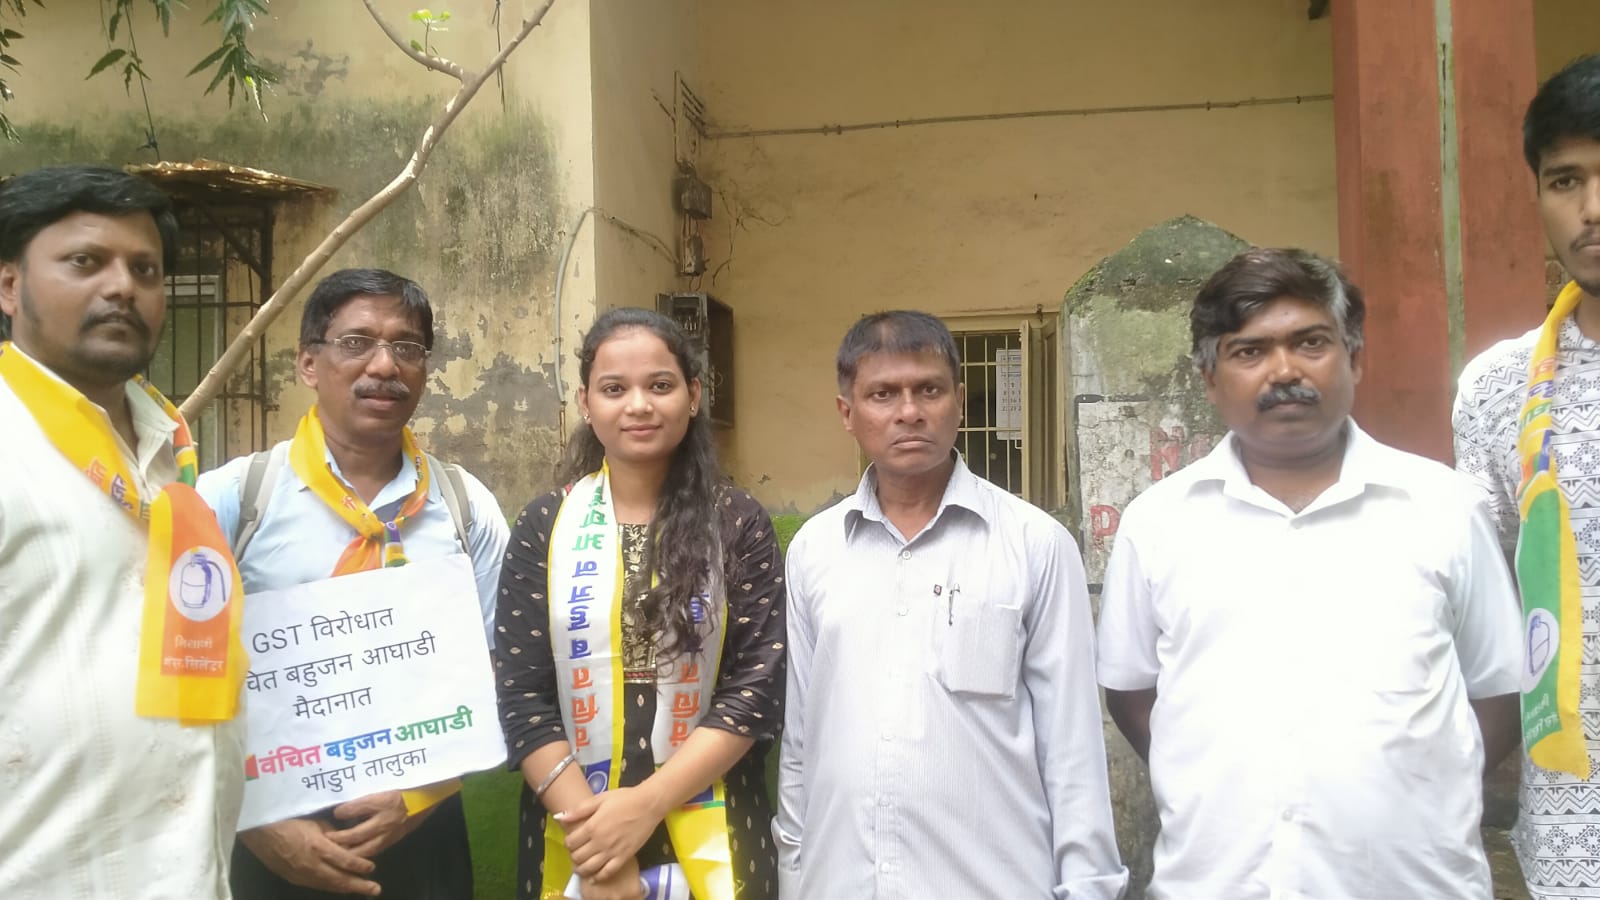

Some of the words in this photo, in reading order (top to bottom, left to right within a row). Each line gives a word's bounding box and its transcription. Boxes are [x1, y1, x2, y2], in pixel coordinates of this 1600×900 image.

[252, 624, 302, 654] GST
[310, 608, 394, 642] विरोधात
[285, 653, 353, 688] बहुजन
[362, 630, 436, 666] आघाडी
[292, 686, 372, 720] मैदानात
[259, 745, 322, 775] वंचित
[324, 728, 392, 762] बहुजन
[394, 704, 473, 742] आघाडी
[301, 764, 357, 793] भांडुप
[364, 747, 427, 777] तालुका
